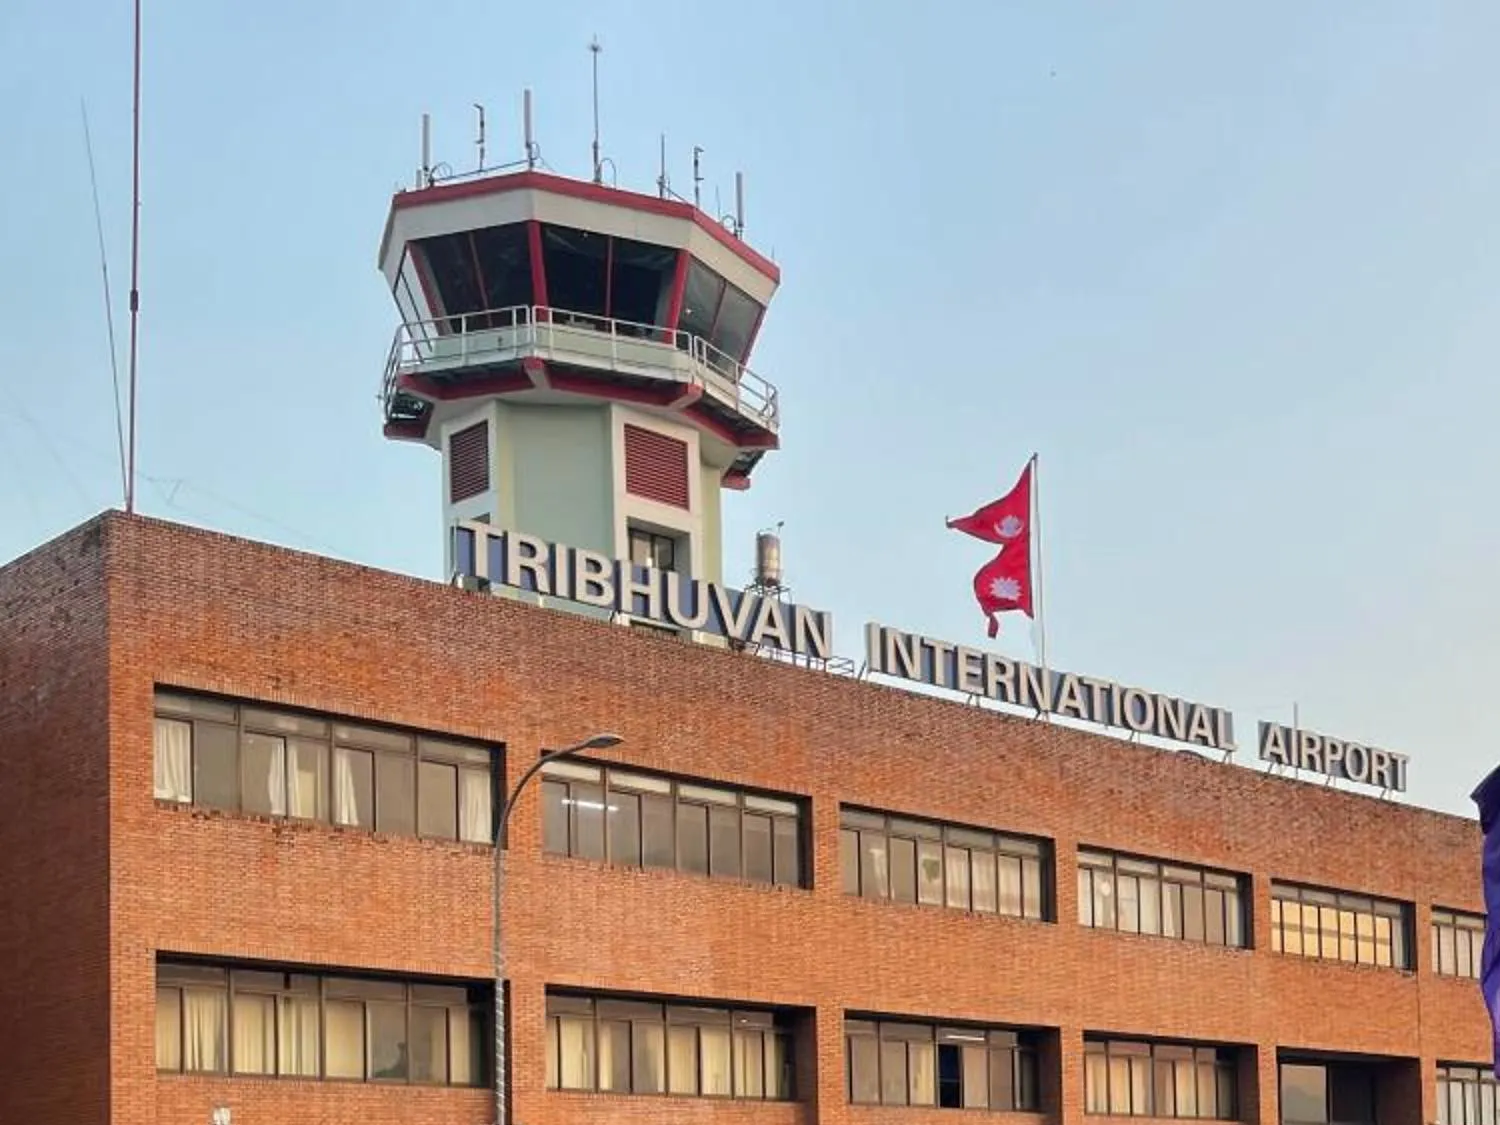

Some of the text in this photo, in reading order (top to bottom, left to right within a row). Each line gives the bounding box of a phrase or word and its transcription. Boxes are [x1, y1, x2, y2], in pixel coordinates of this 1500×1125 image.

[455, 520, 1410, 792] TRIBHUVAN INTERNATIONAL AIRPORT
